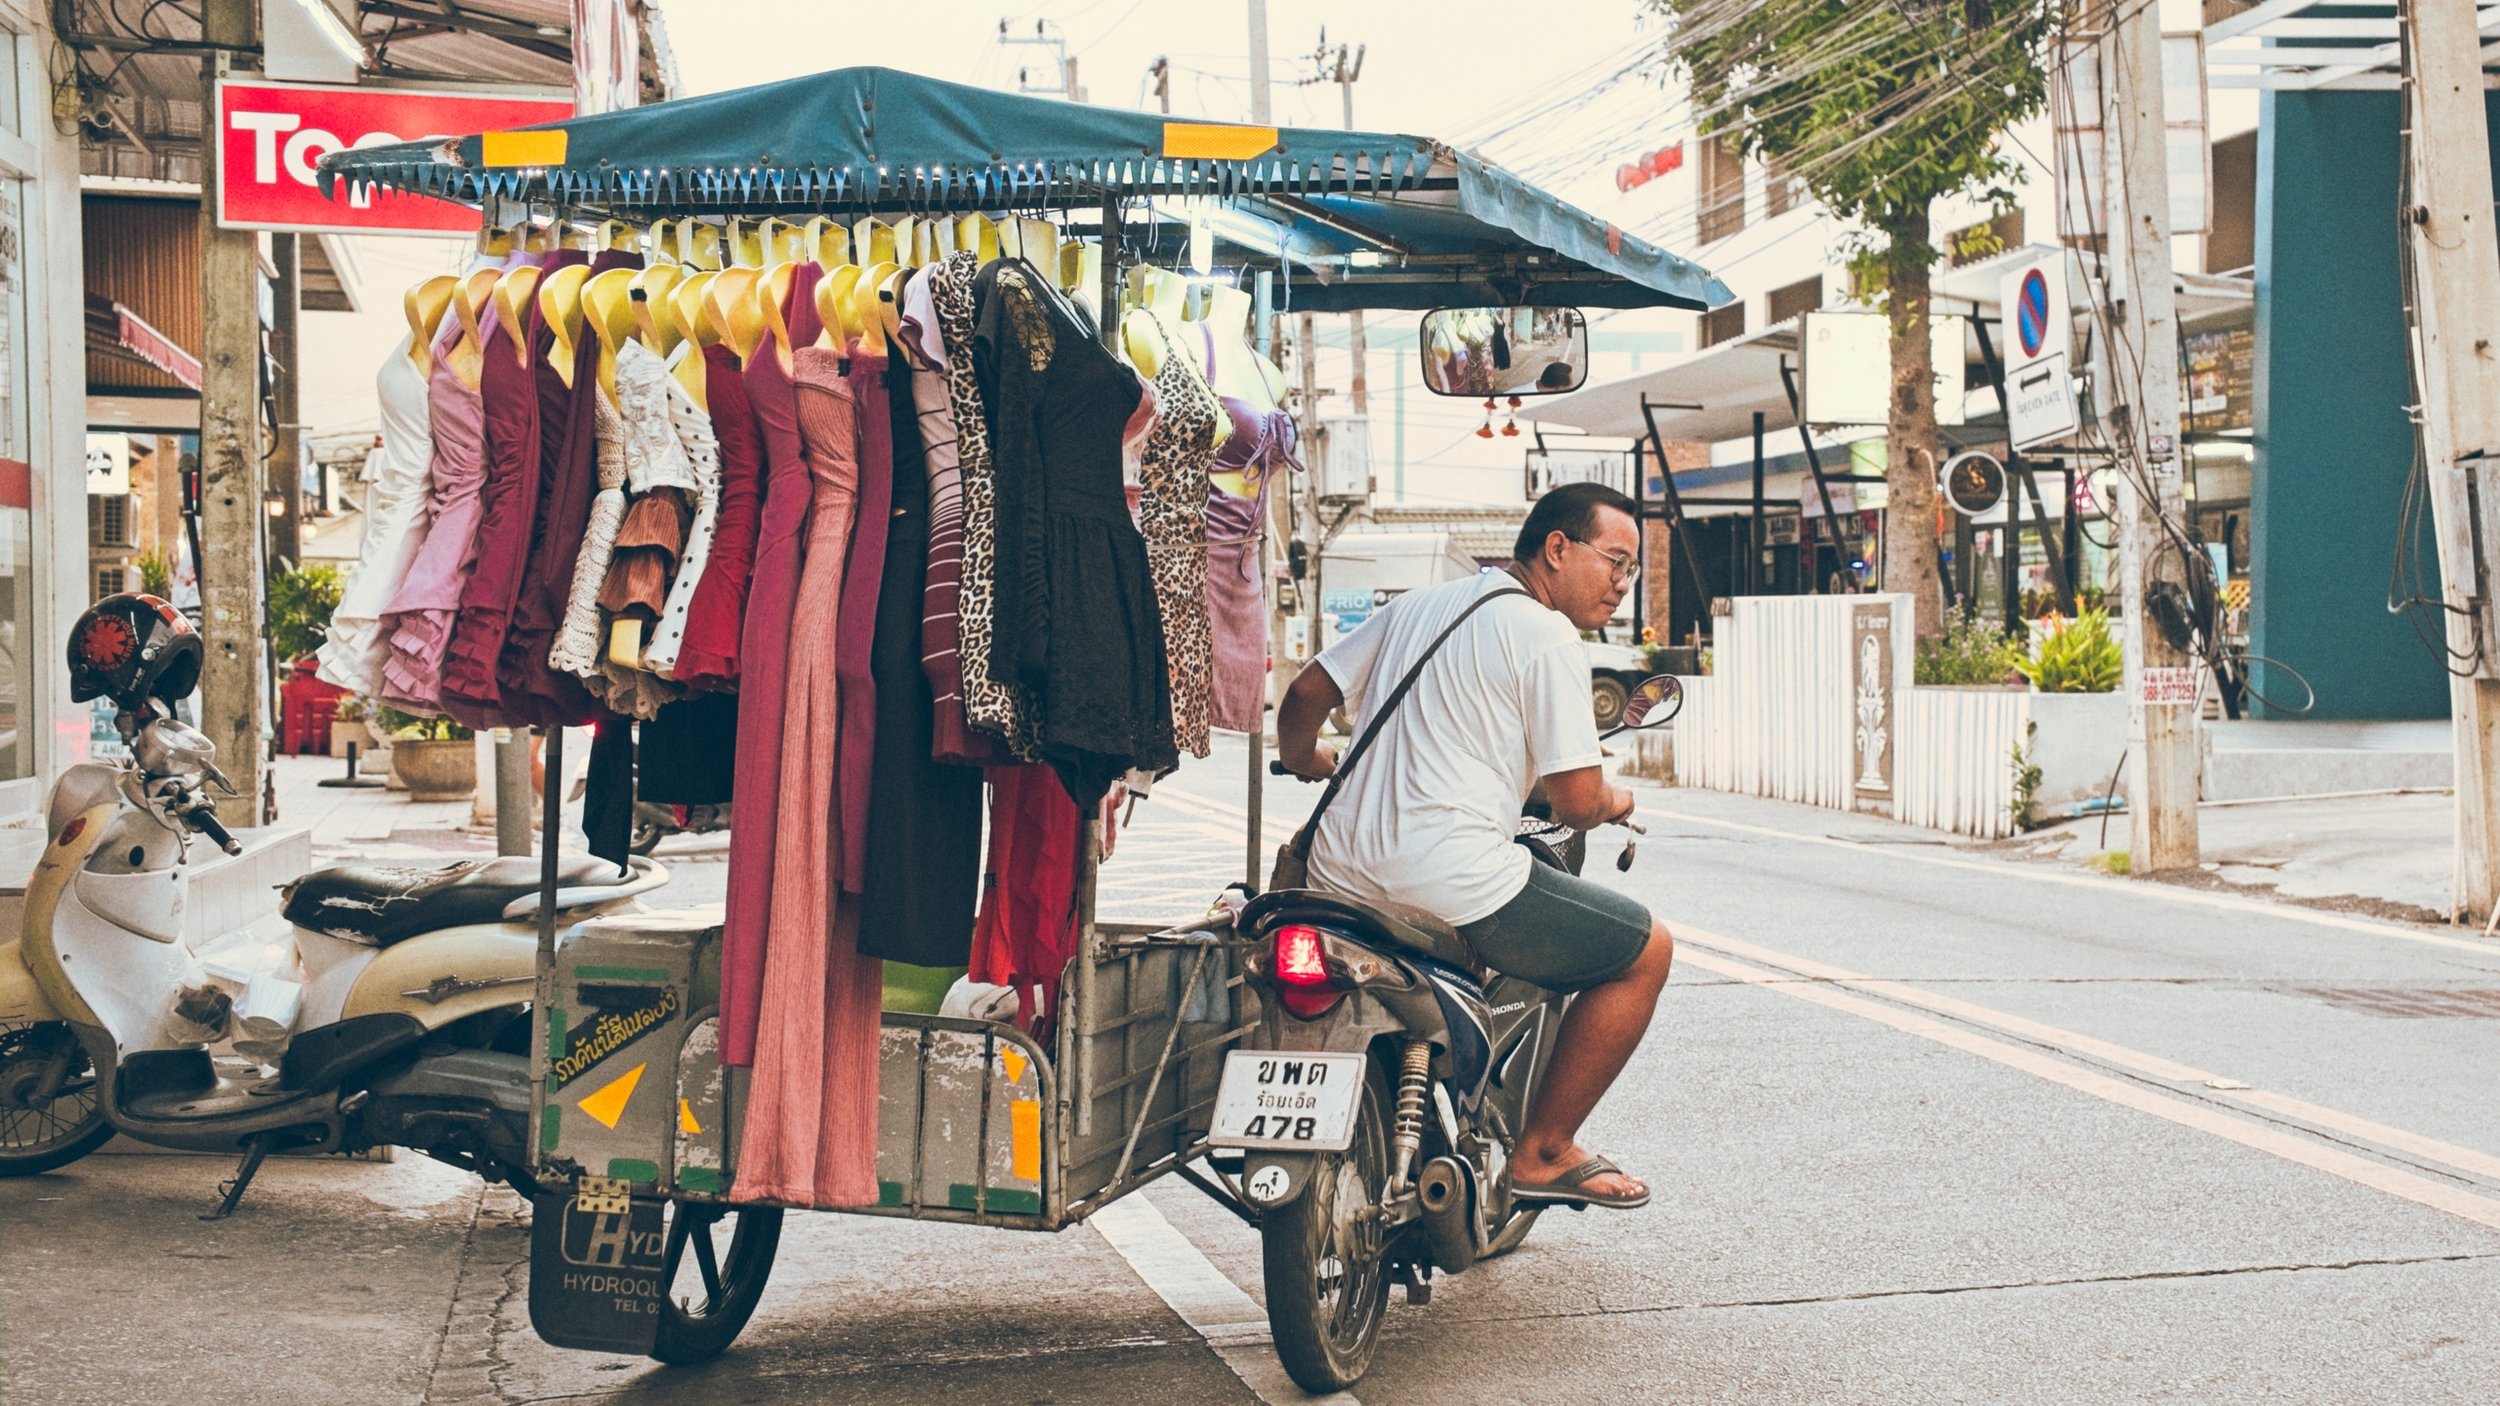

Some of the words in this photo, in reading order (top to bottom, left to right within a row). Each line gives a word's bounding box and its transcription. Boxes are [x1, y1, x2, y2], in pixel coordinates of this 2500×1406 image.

[230, 111, 462, 209] To
[2044, 390, 2061, 406] DATE
[1325, 595, 1366, 610] FRIO
[1492, 1002, 1526, 1015] HONDA
[1257, 1089, 1317, 1109] ร้อยเอ็ด
[1244, 1115, 1317, 1140] 478
[614, 1298, 640, 1312] TEL
